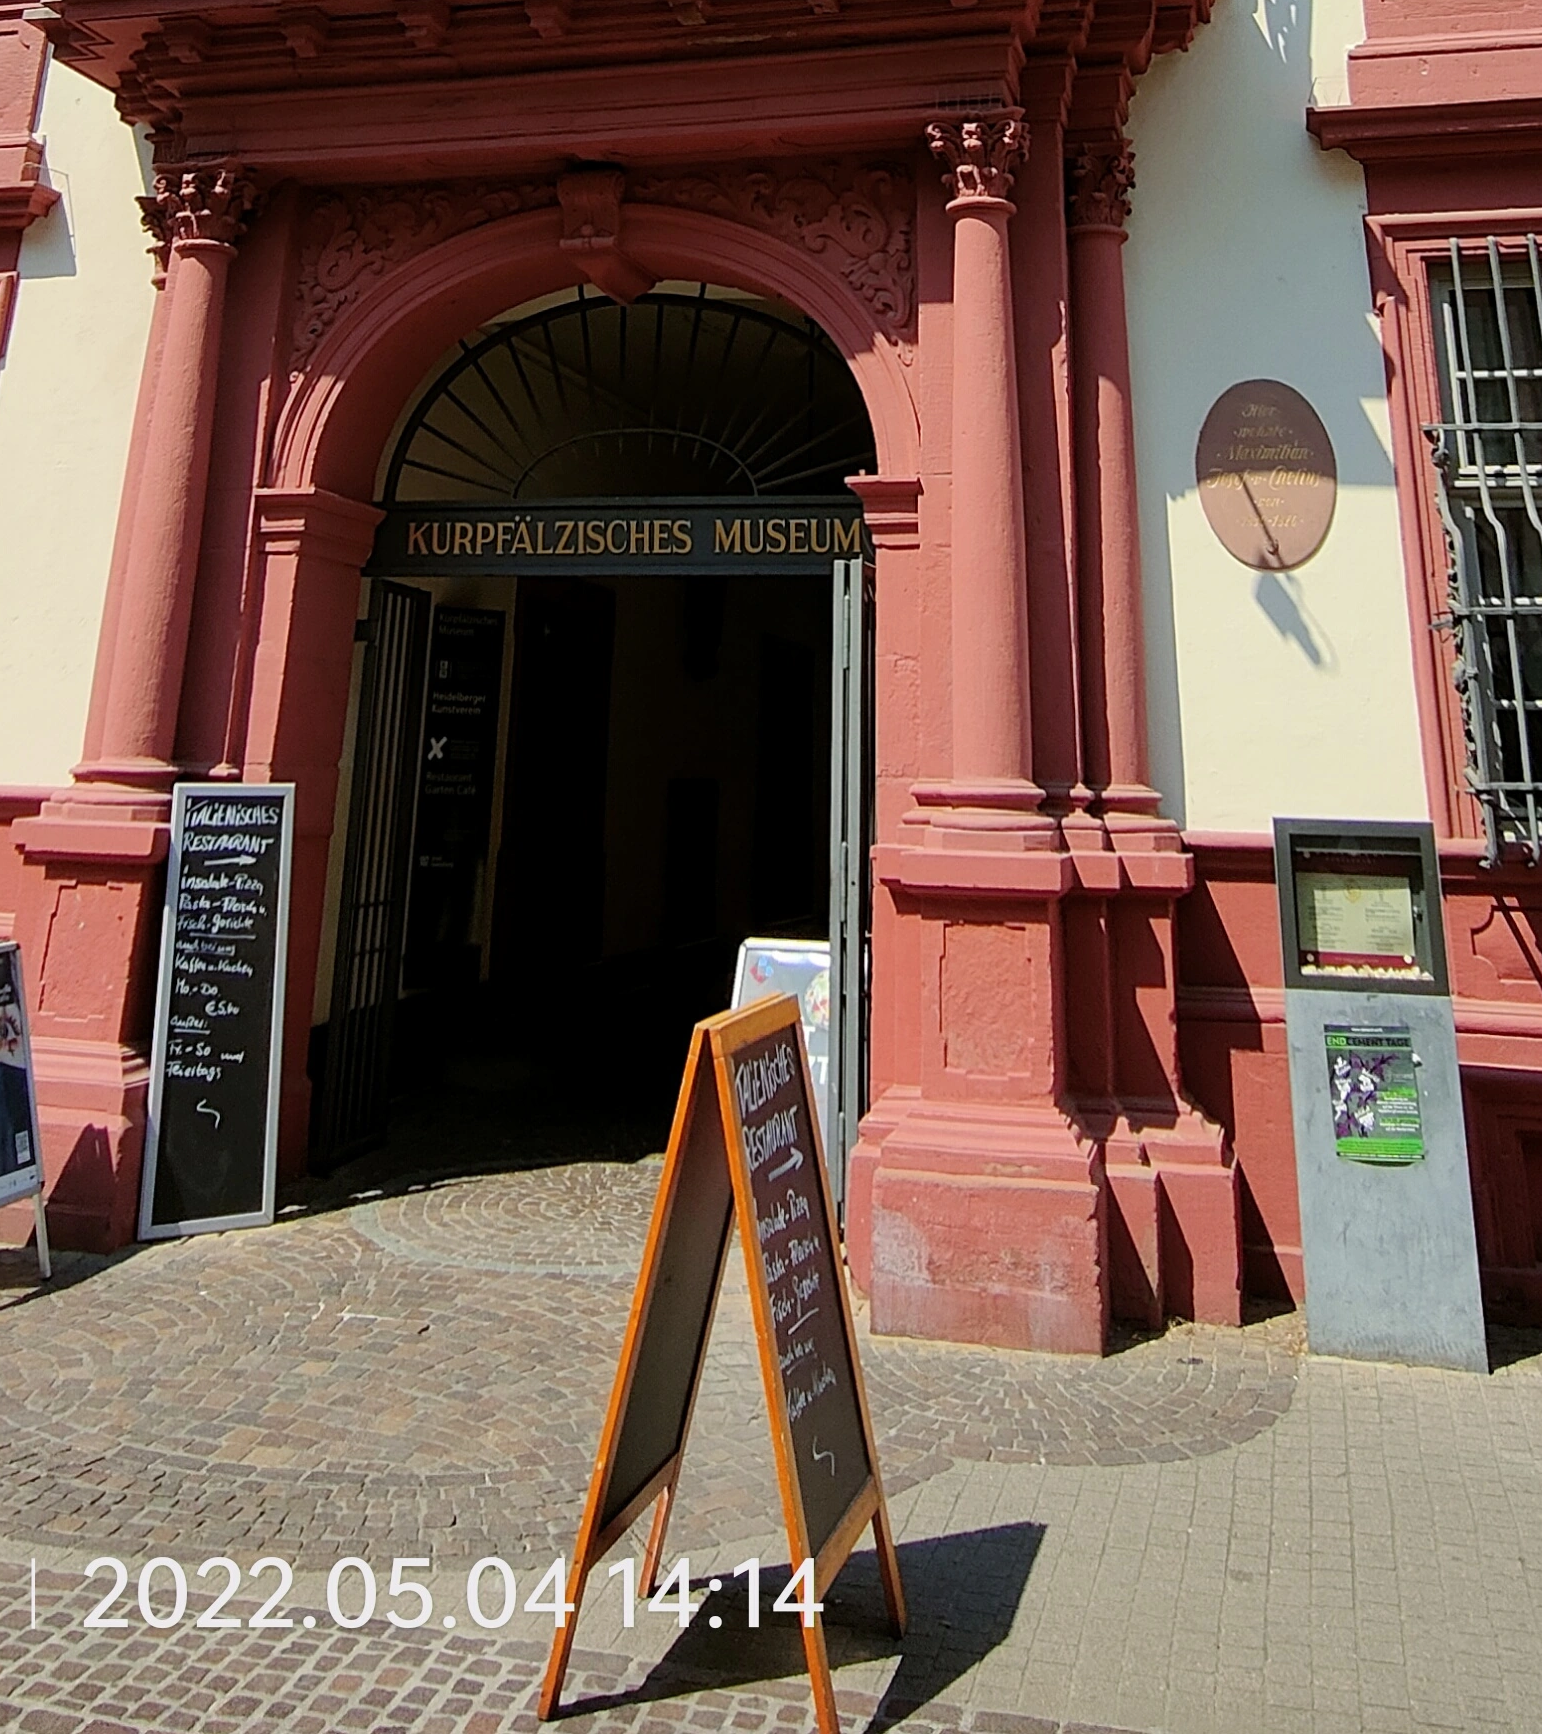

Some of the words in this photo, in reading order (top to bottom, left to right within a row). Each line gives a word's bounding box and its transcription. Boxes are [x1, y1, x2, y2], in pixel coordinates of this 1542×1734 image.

[1228, 440, 1309, 460] Maximilian
[406, 515, 693, 556] KURPFÄLZISCHES
[714, 516, 863, 555] MUSEUM
[433, 691, 486, 706] Heidelberger
[431, 704, 481, 716] Kunstverein
[426, 771, 473, 783] Restaurant
[425, 783, 454, 795] Garten
[182, 831, 275, 854] RESTAURANT
[742, 1104, 799, 1172] RESTAURANT
